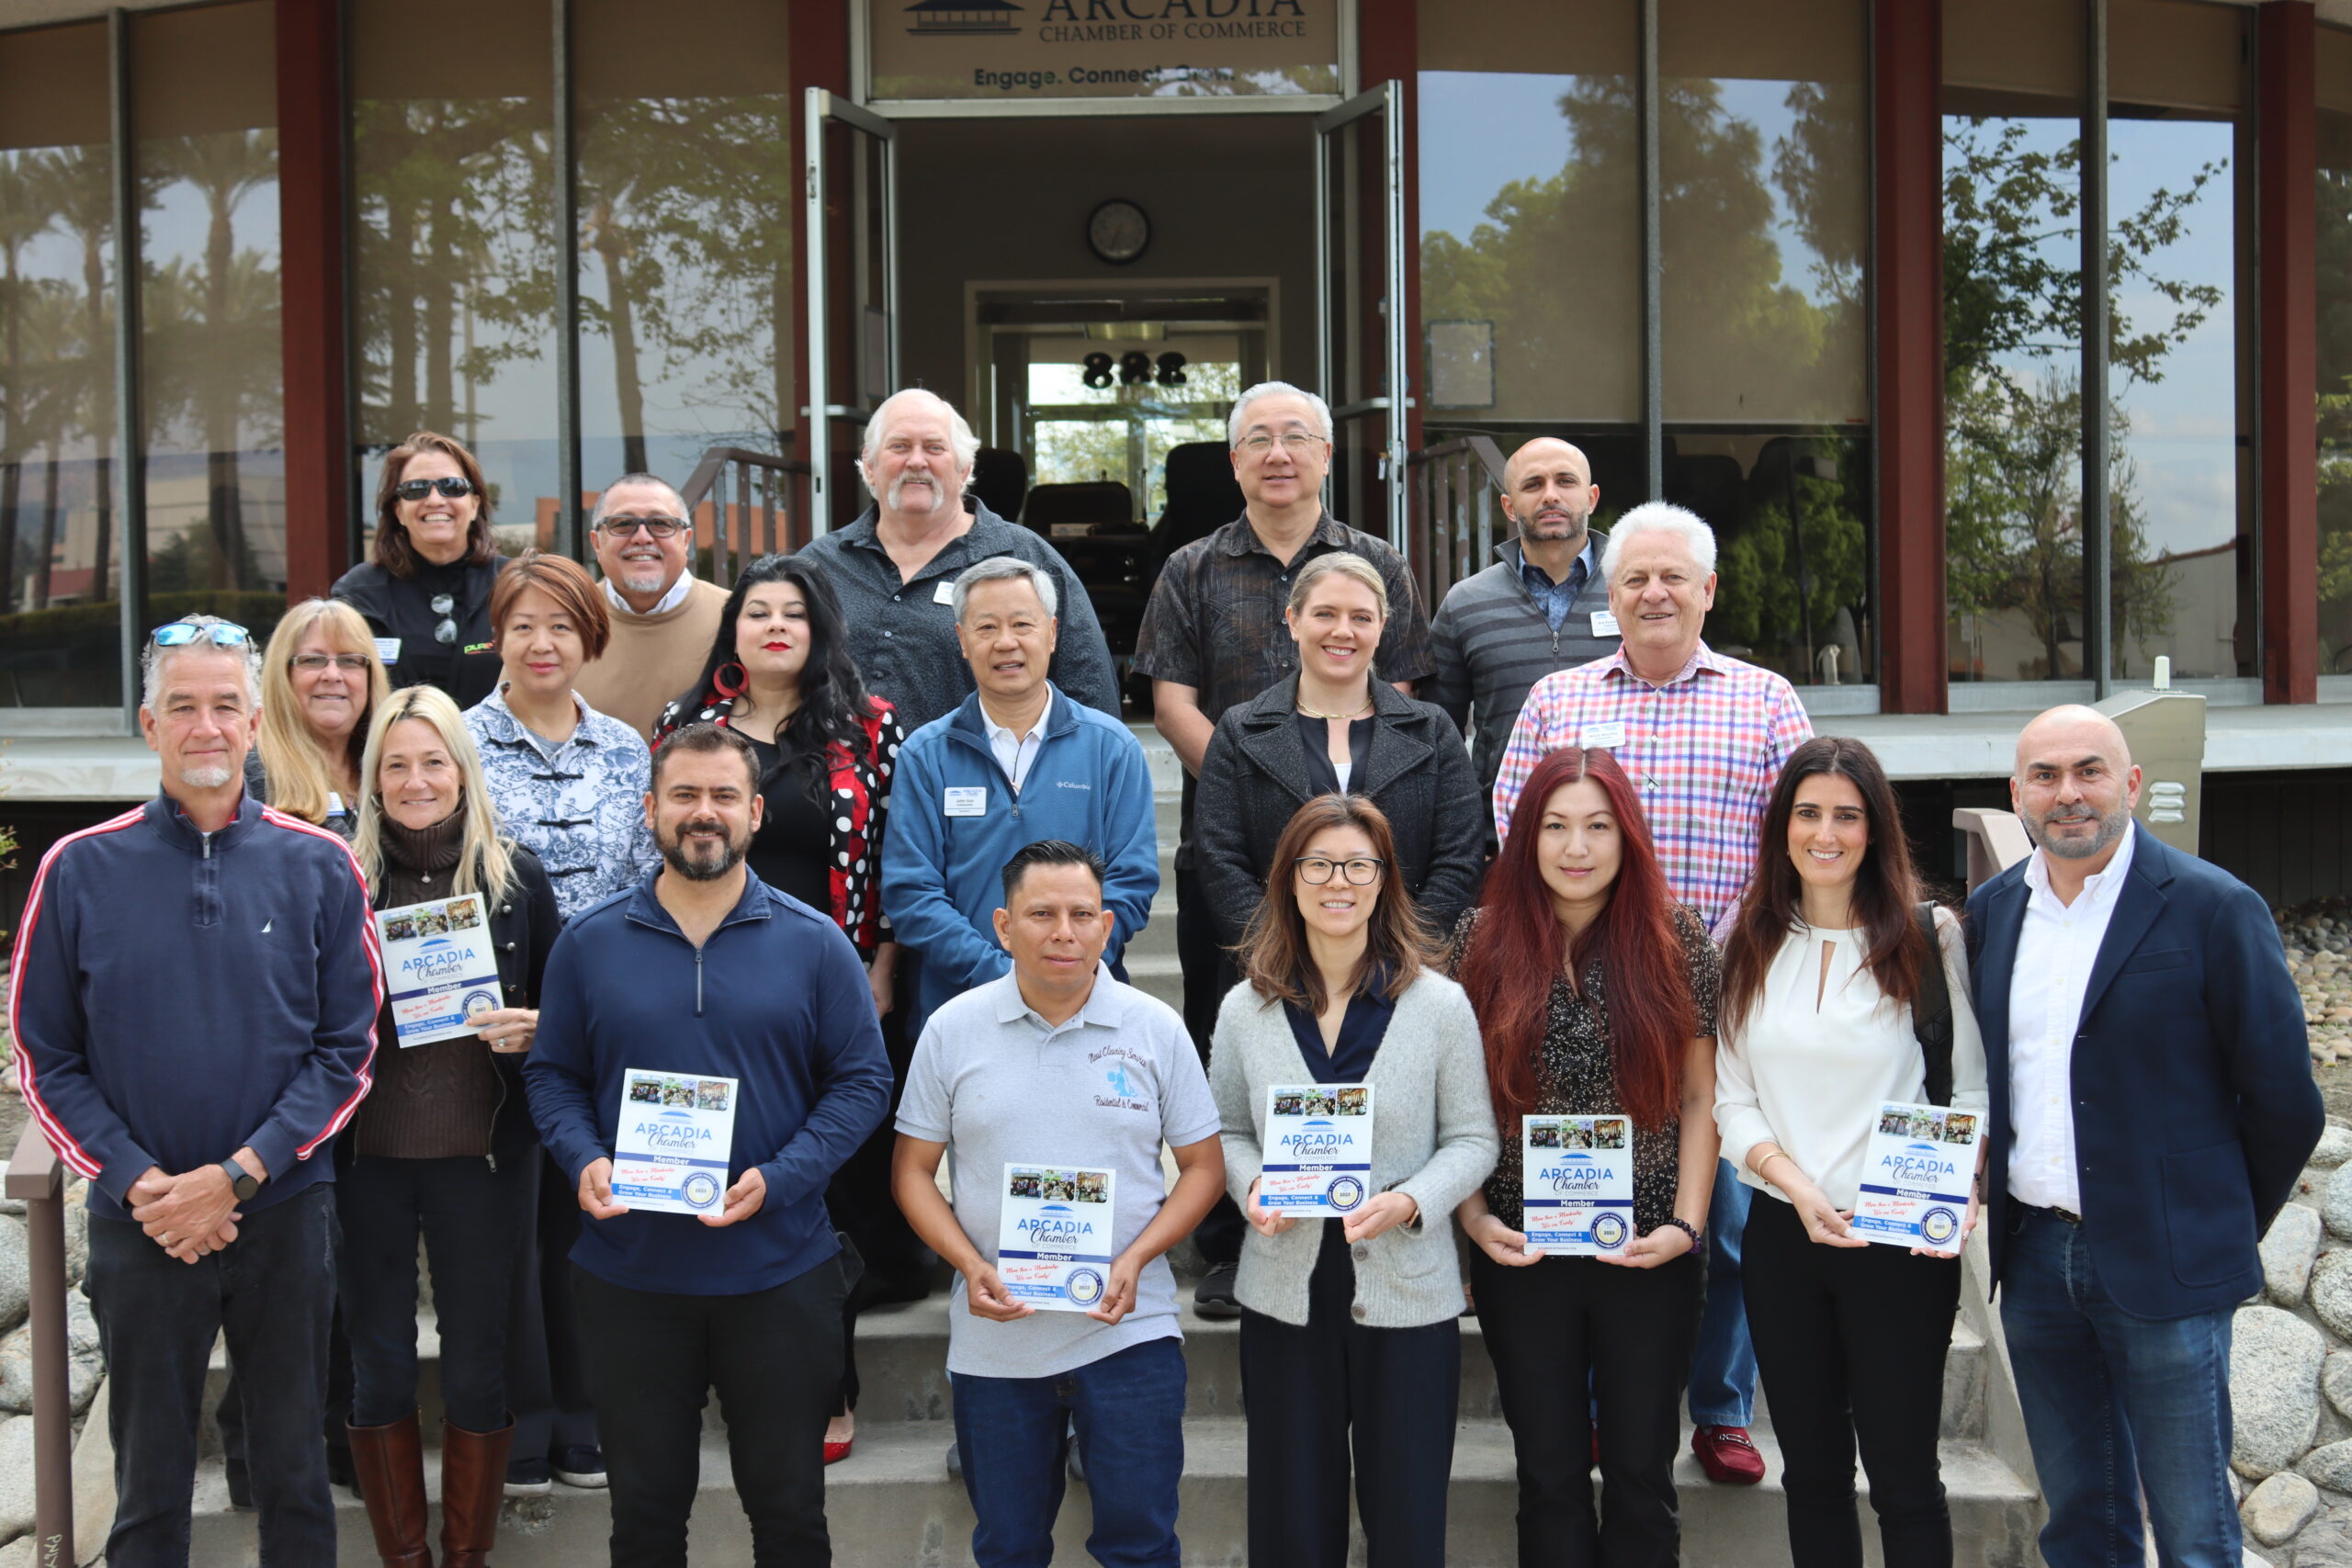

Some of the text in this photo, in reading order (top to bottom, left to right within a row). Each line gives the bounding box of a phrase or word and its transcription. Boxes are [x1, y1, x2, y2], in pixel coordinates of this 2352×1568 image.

[1039, 21, 1306, 42] CHAMBER OF COMMERCE
[974, 68, 1062, 90] Engage.
[401, 947, 476, 972] ARCADIA
[417, 963, 463, 982] Chamber
[427, 982, 462, 995] Member
[1102, 1044, 1125, 1060] Cleaning
[634, 1122, 712, 1140] ARCADIA
[1280, 1134, 1353, 1145] ARCADIA
[648, 1132, 696, 1149] Chamber
[1293, 1141, 1339, 1157] Chamber
[653, 1155, 690, 1166] Member
[1881, 1155, 1955, 1175] ARCADIA
[1539, 1168, 1613, 1179] ARCADIA
[1893, 1164, 1939, 1183] Chamber
[1553, 1175, 1600, 1191] Chamber
[1896, 1189, 1931, 1200] Member
[1017, 1218, 1093, 1235] ARCADIA
[1030, 1227, 1079, 1244] Chamber
[1036, 1252, 1072, 1261] Member
